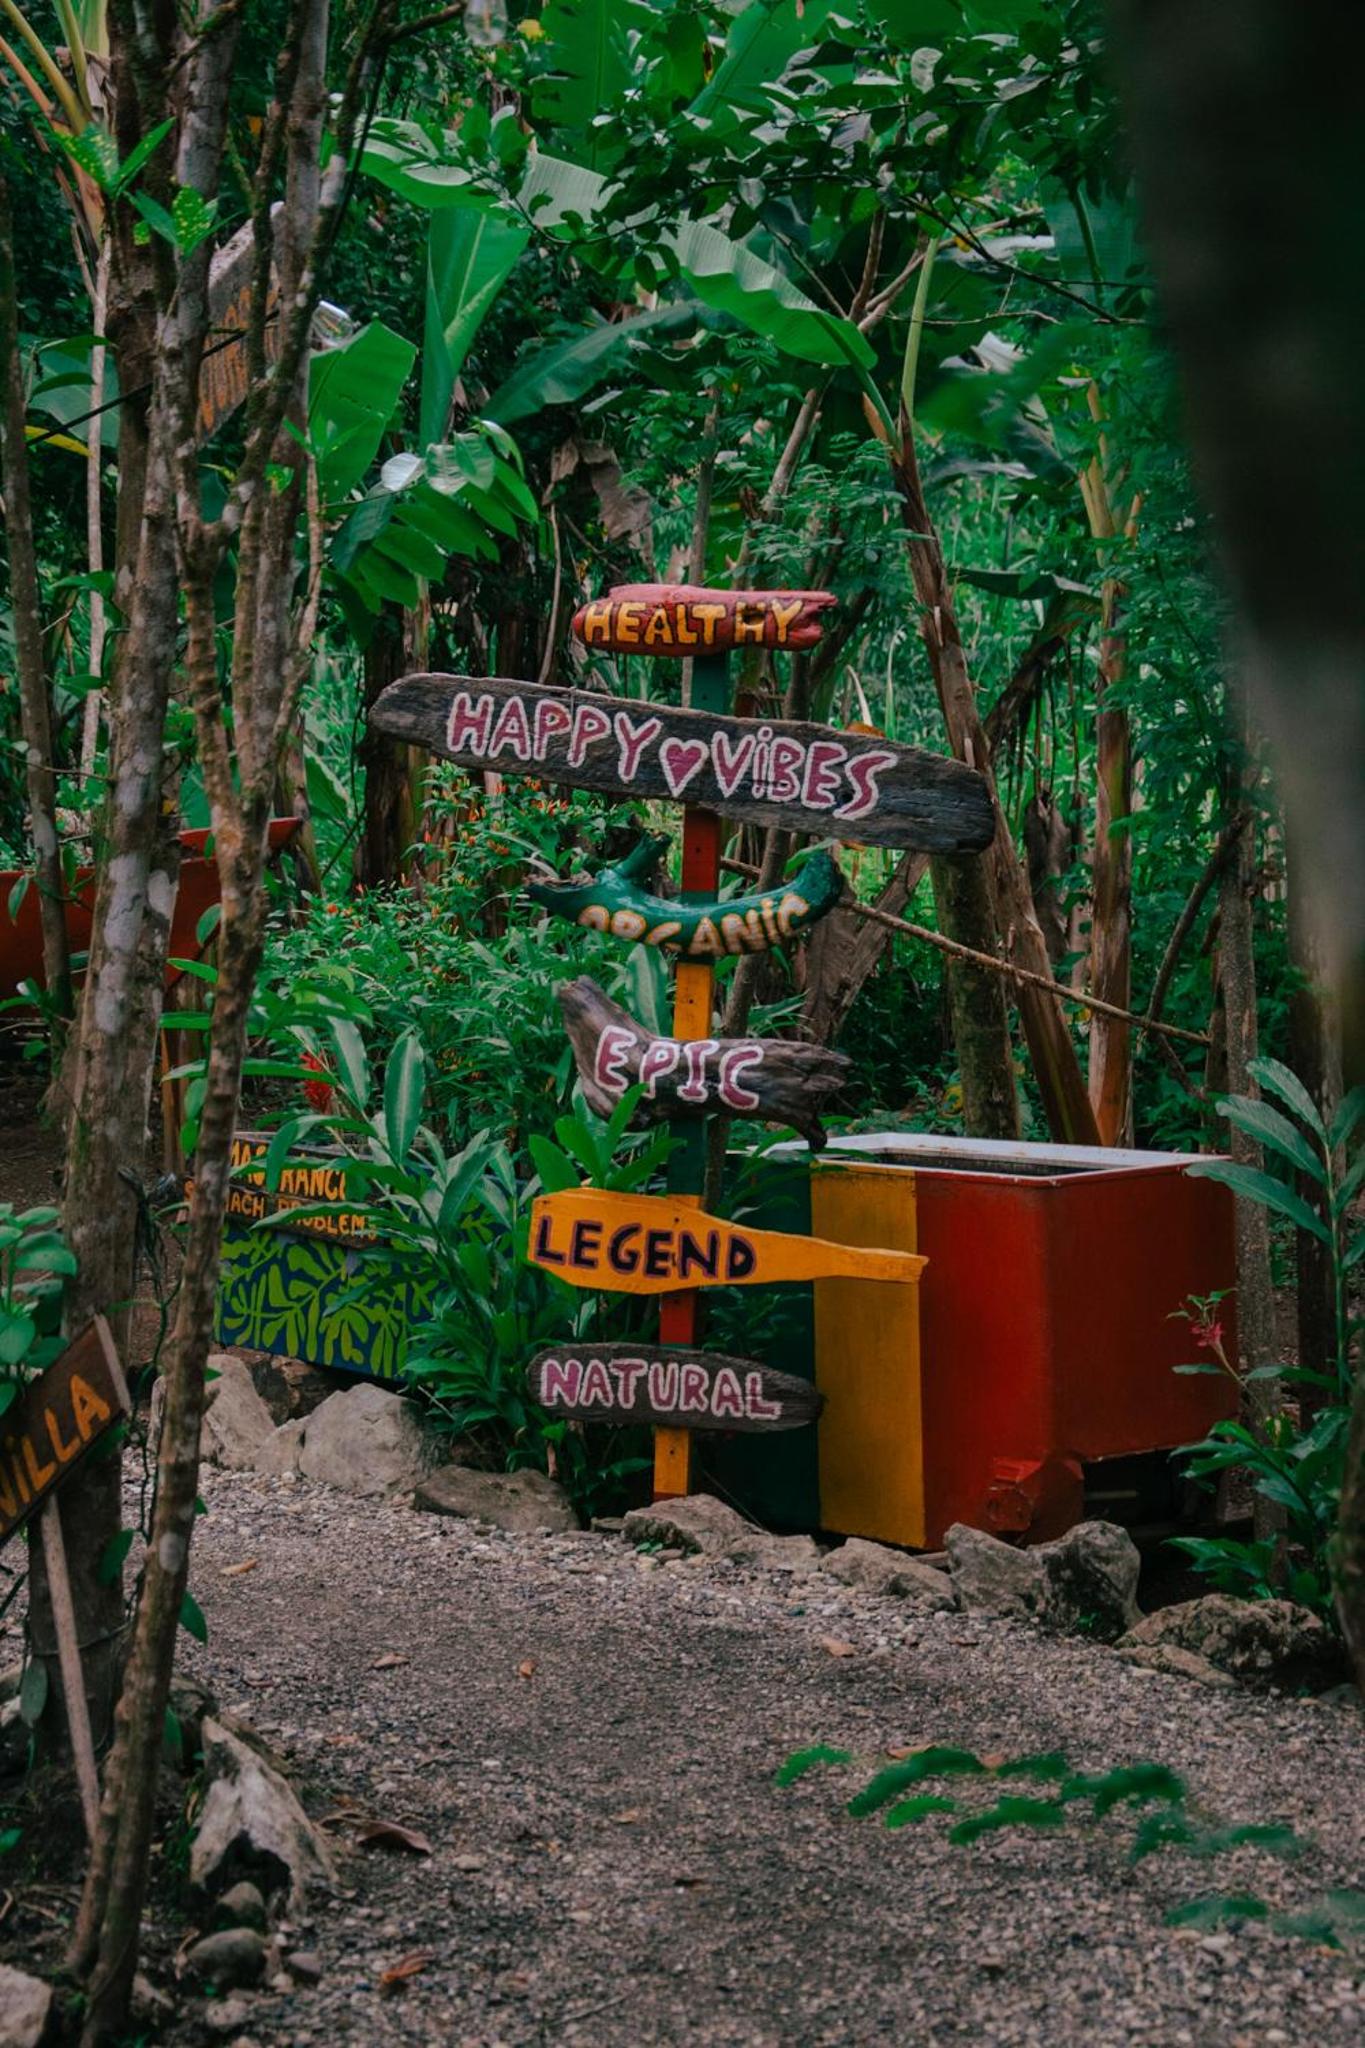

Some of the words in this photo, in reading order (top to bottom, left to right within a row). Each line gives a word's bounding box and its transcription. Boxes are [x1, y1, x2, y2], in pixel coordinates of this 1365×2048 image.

[584, 601, 803, 644] HEALTHY
[447, 693, 662, 782] HAPPY
[595, 1025, 764, 1110] EPIC
[534, 1215, 756, 1279] LEGEND
[540, 1358, 783, 1420] NATURAL
